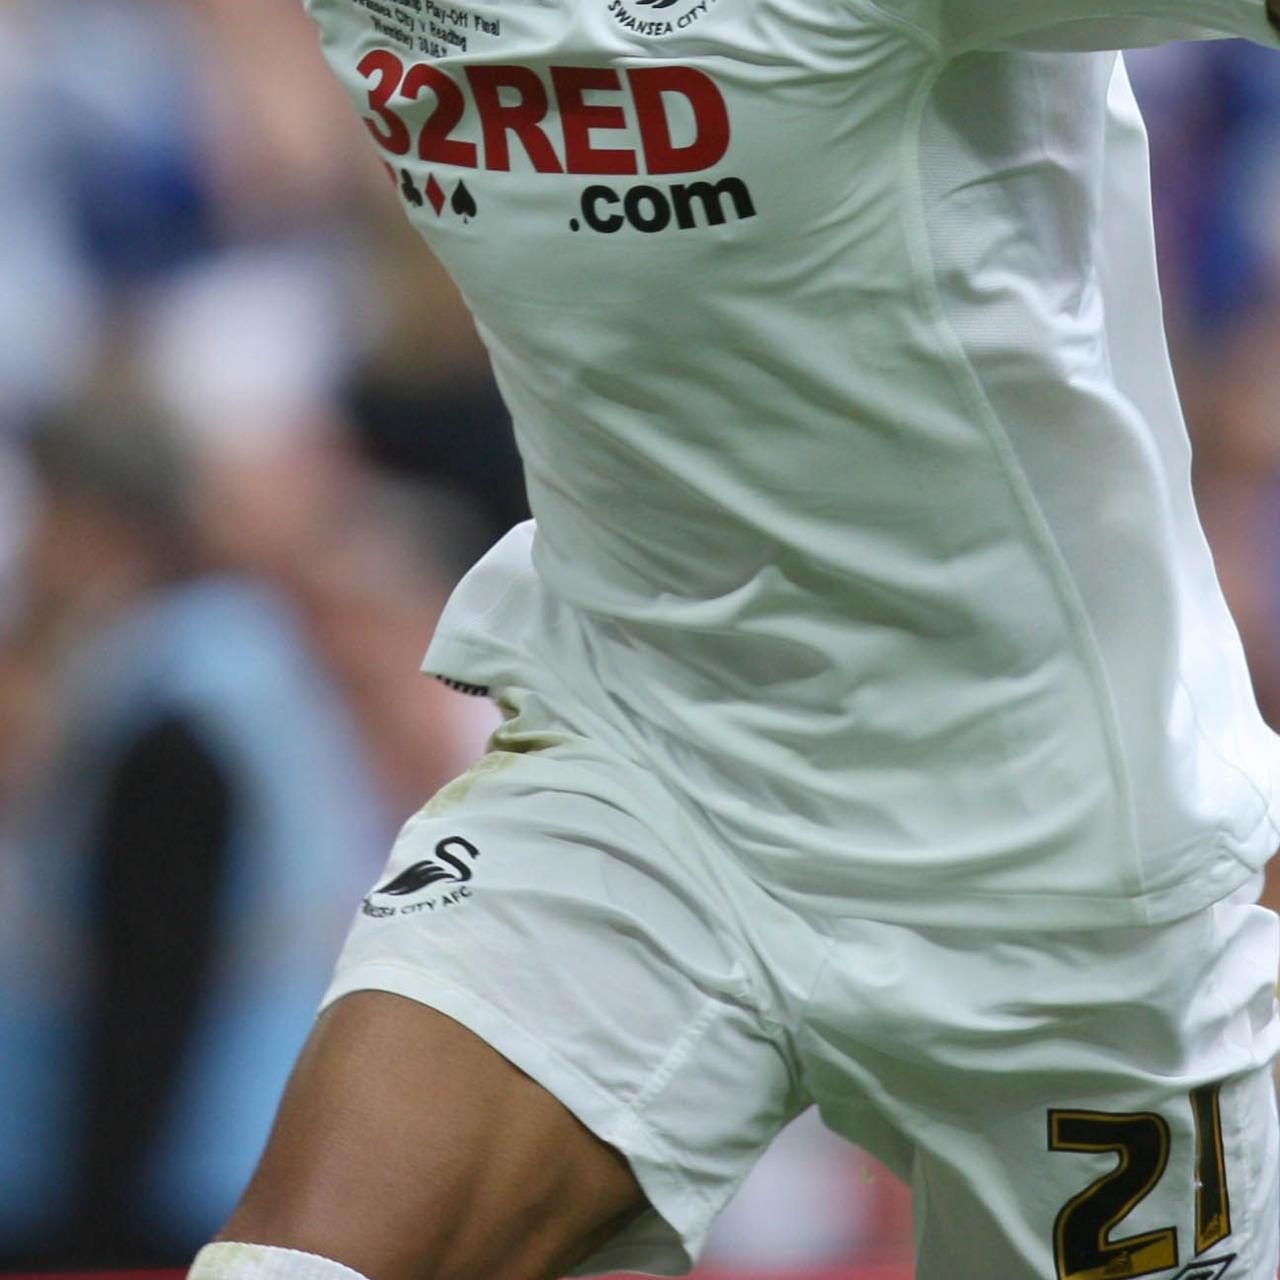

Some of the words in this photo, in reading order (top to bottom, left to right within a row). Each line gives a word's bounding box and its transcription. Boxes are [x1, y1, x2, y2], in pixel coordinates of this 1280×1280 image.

[474, 15, 501, 37] Final
[607, 0, 673, 37] SWANSEA
[676, 1, 709, 29] CITY
[356, 48, 731, 176] 32RED
[569, 175, 757, 235] .com
[401, 898, 437, 915] CITY
[441, 885, 473, 908] AFC
[1047, 1082, 1232, 1280] 21
